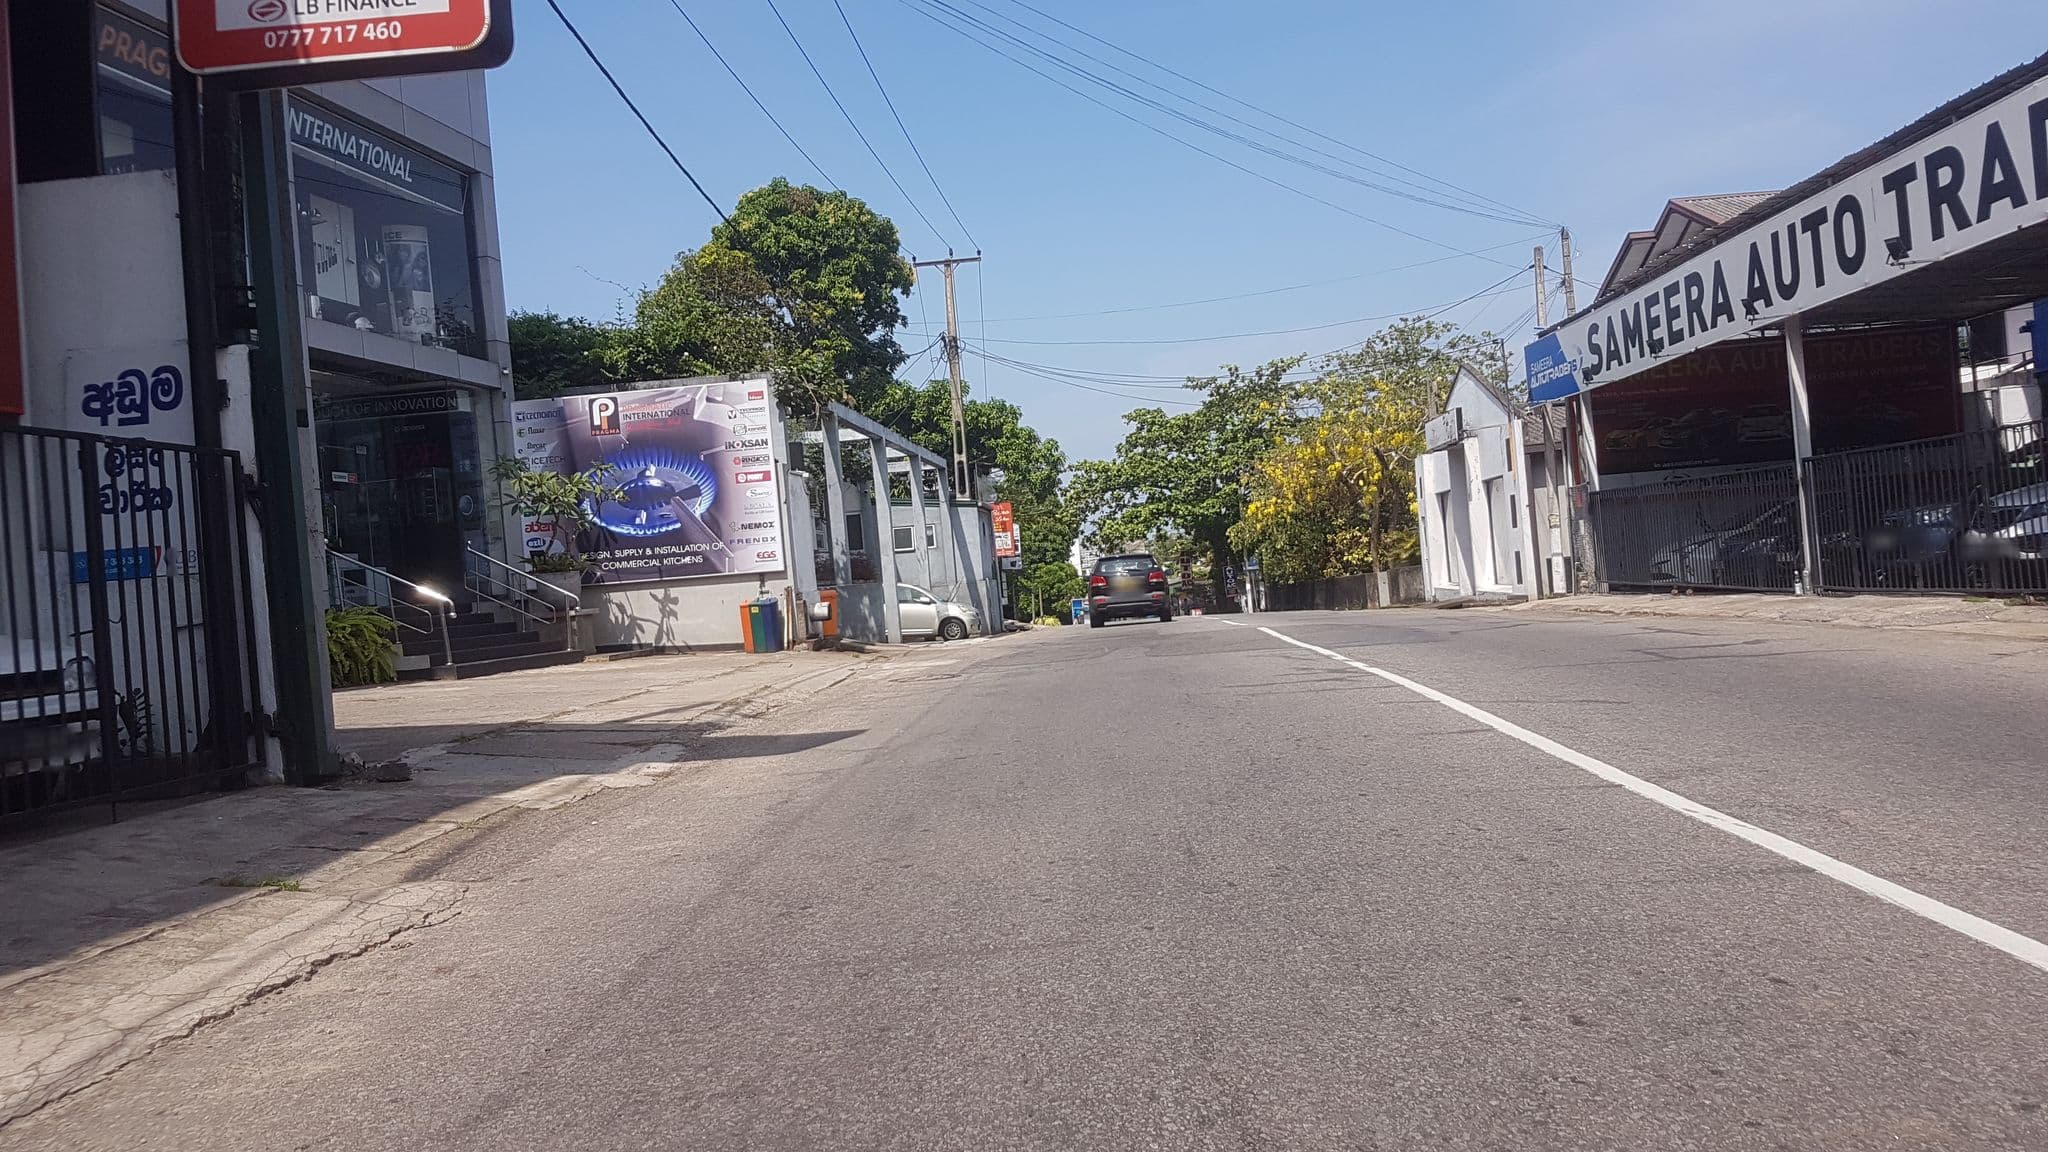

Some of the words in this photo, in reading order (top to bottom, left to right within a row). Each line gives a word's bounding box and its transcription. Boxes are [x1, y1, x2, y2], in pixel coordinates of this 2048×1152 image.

[264, 27, 314, 48] 0777
[320, 24, 358, 45] 717
[362, 21, 402, 41] 460
[98, 24, 171, 80] PRAG
[288, 107, 413, 183] NTERNATIONAL
[1588, 260, 1735, 375] SAMEERA
[1746, 194, 1867, 312] AUTO
[375, 396, 457, 413] INNOVATION
[622, 409, 690, 421] INTERNATIONAL
[531, 456, 567, 465] ICETECH
[741, 521, 775, 530] NEMOX
[614, 548, 644, 558] SUPPLY
[646, 547, 652, 556] &
[654, 543, 710, 555] INSTALLATION
[712, 541, 724, 551] OF
[729, 537, 777, 546] FRENOX
[601, 558, 662, 570] COMMERCIAL
[663, 555, 704, 566] KITCHENS
